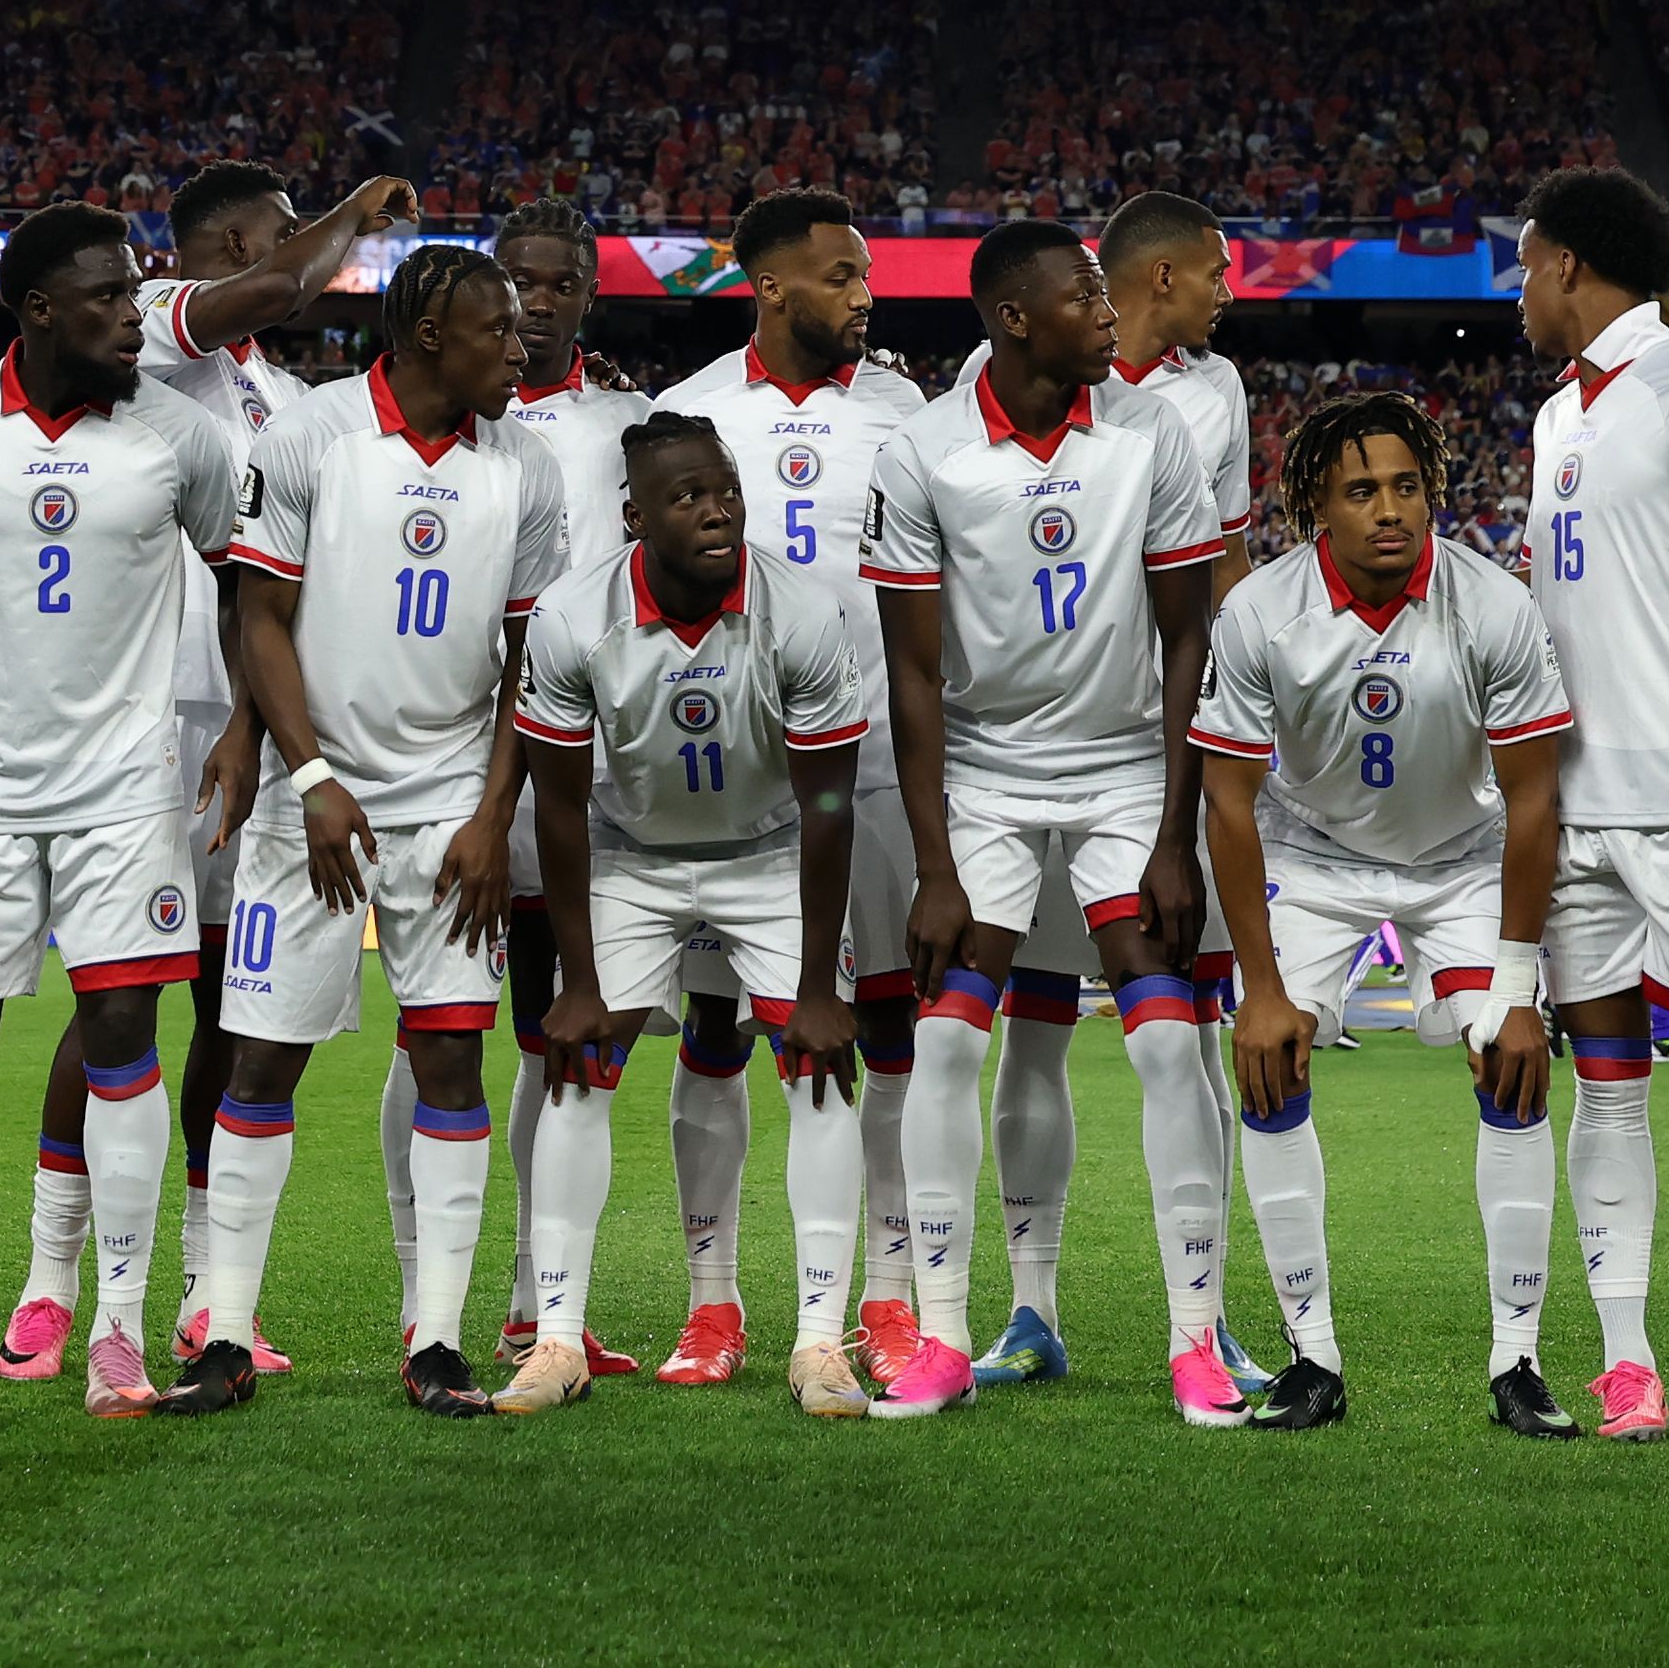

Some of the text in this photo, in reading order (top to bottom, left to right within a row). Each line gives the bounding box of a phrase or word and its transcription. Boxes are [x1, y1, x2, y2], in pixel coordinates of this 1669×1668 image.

[768, 422, 831, 435] SAETA
[22, 462, 89, 475] SAETA
[396, 484, 459, 502] SAETA
[1019, 480, 1081, 497] SAETA
[786, 499, 817, 565] 5
[1551, 510, 1584, 581] 15
[37, 545, 71, 613] 2
[395, 567, 450, 637] 10
[1032, 562, 1087, 633] 17
[665, 666, 726, 682] SAETA
[678, 741, 724, 792] 11
[1360, 732, 1395, 789] 8
[233, 901, 277, 973] 10
[224, 974, 273, 994] SAETA
[689, 1213, 718, 1228] FHF
[920, 1221, 953, 1235] FHF
[104, 1233, 136, 1248] FHF
[1579, 1227, 1608, 1239] FHF
[1186, 1238, 1213, 1255] FHF
[541, 1269, 569, 1282] FHF
[806, 1267, 834, 1282] FHF
[1285, 1267, 1315, 1287] FHF
[1513, 1272, 1542, 1287] FHF
